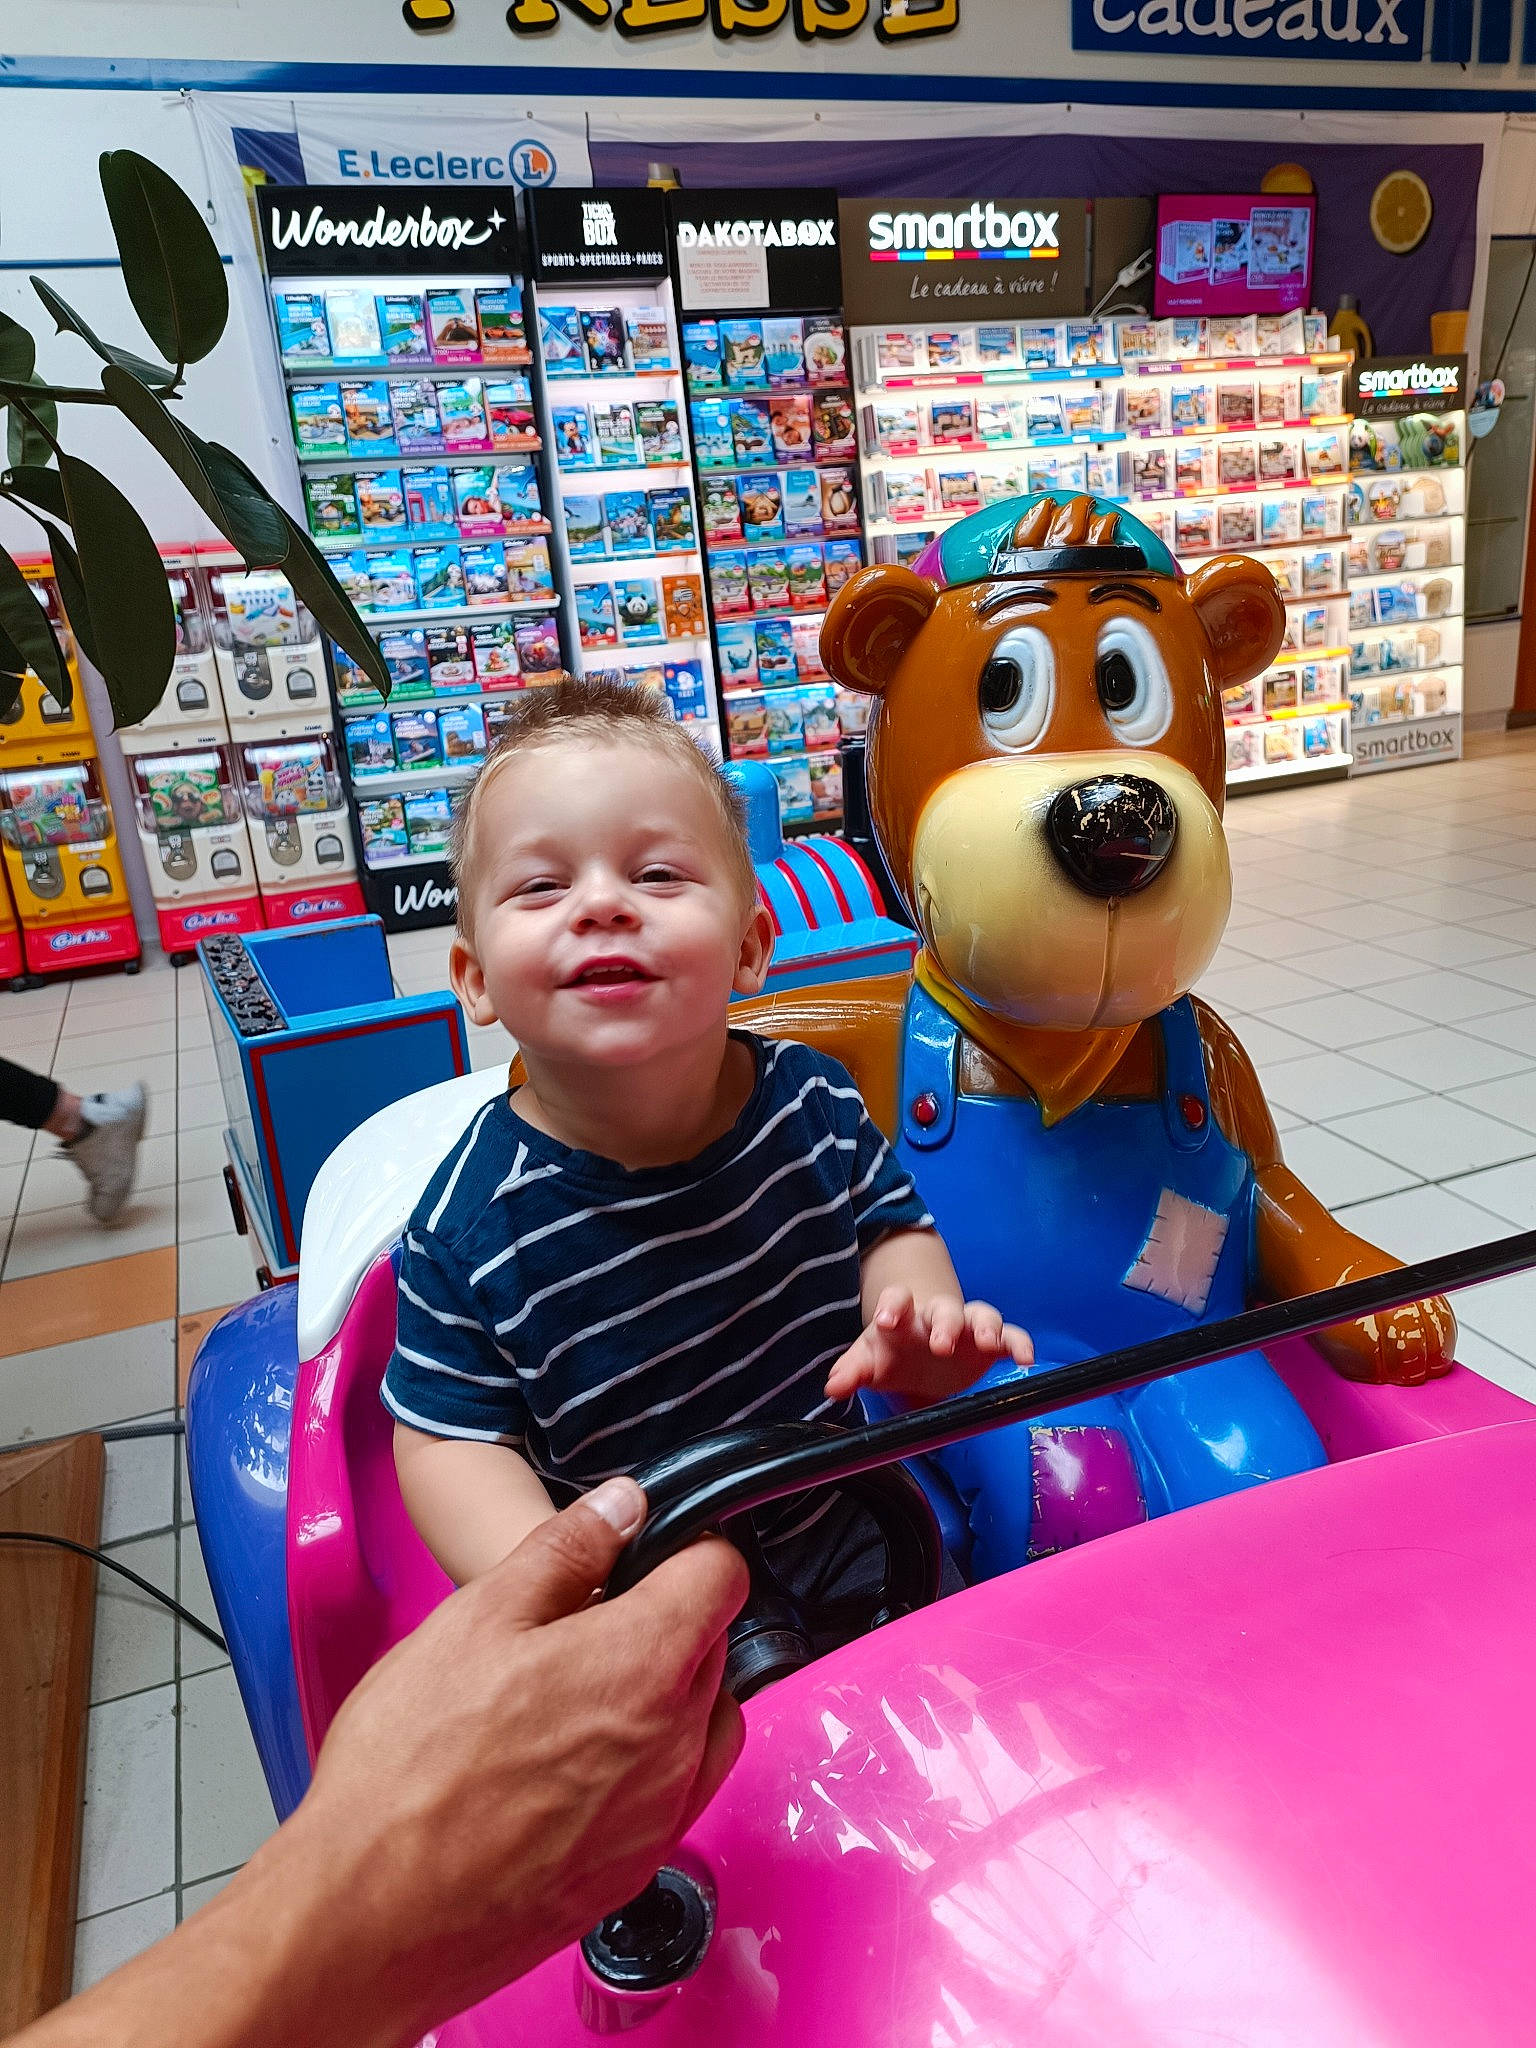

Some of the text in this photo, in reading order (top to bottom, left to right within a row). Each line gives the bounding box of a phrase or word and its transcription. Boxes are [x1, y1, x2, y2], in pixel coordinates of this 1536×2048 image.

[337, 149, 504, 180] E.Leclerc
[271, 204, 493, 250] Wonderbox
[582, 218, 618, 246] BOX
[678, 219, 836, 248] DAKOTABOX
[868, 201, 1060, 250] smartbox
[910, 274, 930, 299] Le
[934, 276, 990, 297] cadeau
[993, 275, 1006, 295] à
[1008, 276, 1046, 295] vivre
[1359, 363, 1459, 392] smartbox
[1356, 728, 1455, 757] smartbox
